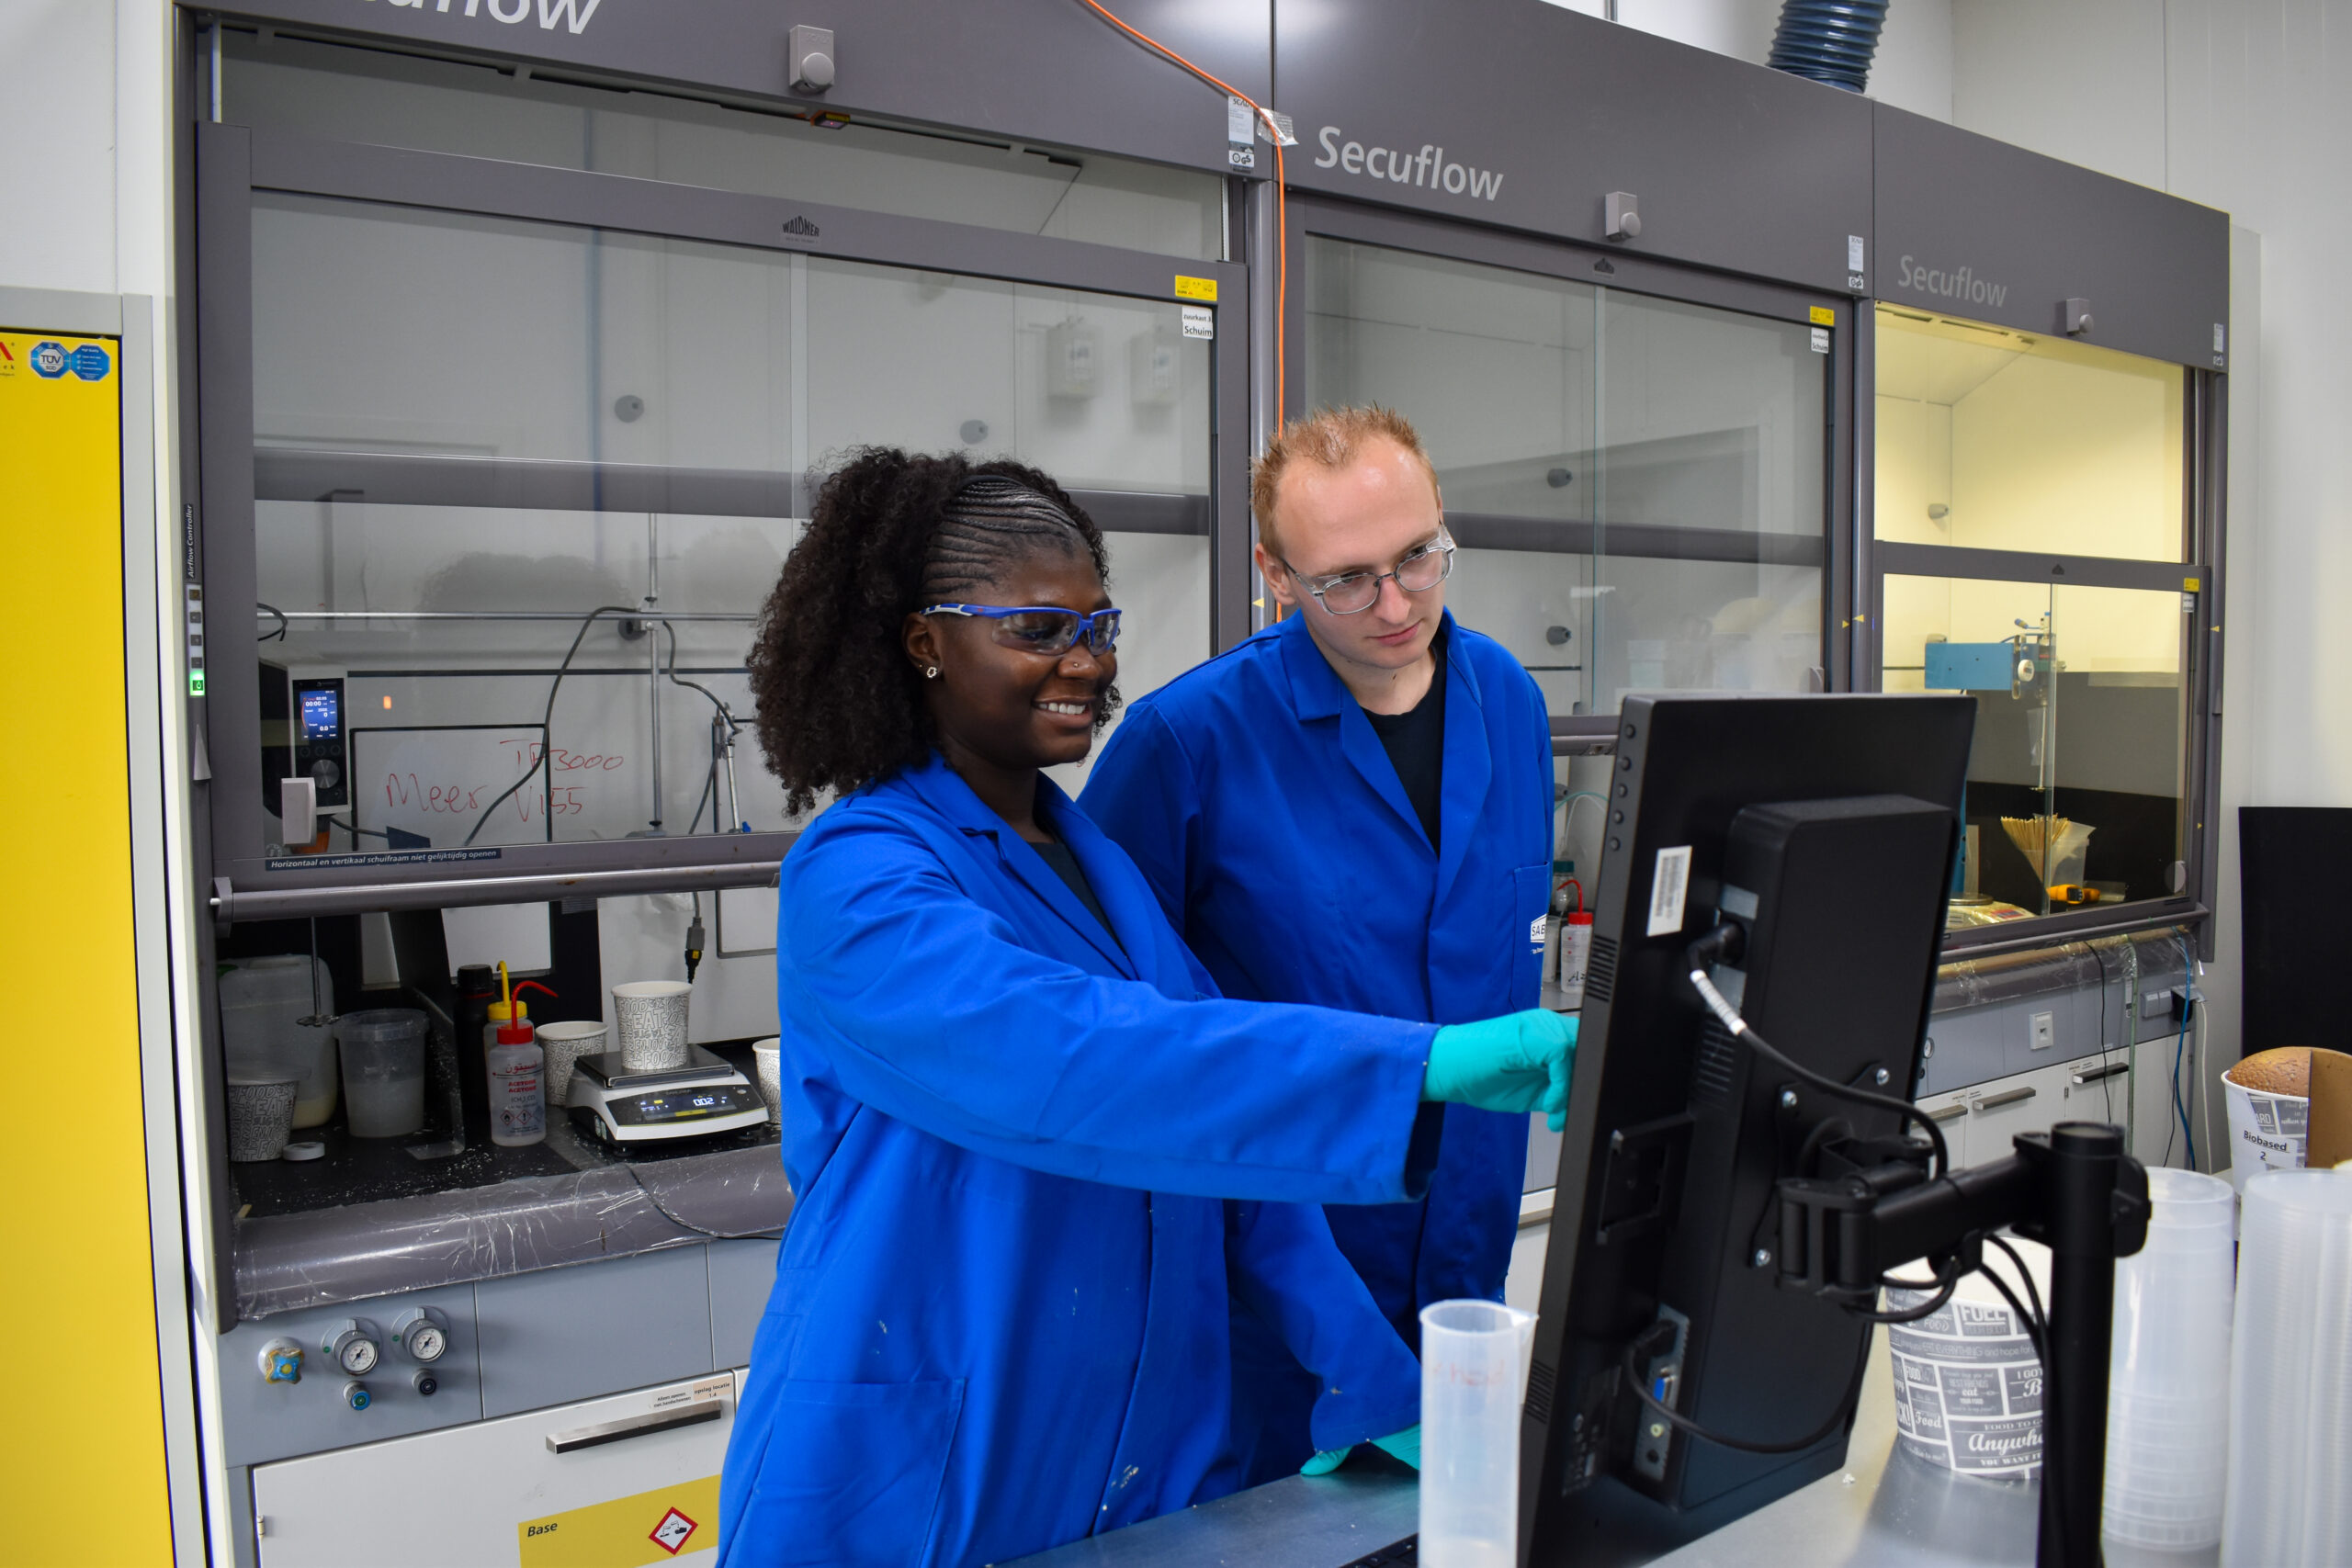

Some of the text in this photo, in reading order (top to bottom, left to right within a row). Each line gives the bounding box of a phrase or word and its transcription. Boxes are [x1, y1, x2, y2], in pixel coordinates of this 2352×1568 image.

[1314, 126, 1505, 201] Secuflow
[1896, 254, 2007, 308] Secuflow
[1184, 325, 1212, 336] Schuim
[186, 504, 195, 579] Airflow Controller
[271, 859, 318, 868] Horizontaal
[332, 856, 366, 865] vertikaal
[368, 854, 409, 863] schuifraam
[427, 852, 467, 862] gelijktijdig
[469, 850, 496, 858] openen
[632, 1009, 665, 1030] EAT
[2244, 1130, 2287, 1151] Biobased
[2260, 1151, 2267, 1160] 2
[694, 1386, 712, 1394] opslag
[1962, 1387, 1979, 1396] eat
[1915, 1411, 1943, 1428] Food
[1984, 1420, 2014, 1431] FOOD
[2018, 1419, 2031, 1427] TO
[1980, 1458, 1998, 1466] YOU
[2003, 1456, 2030, 1465] WANT
[527, 1522, 558, 1538] Base
